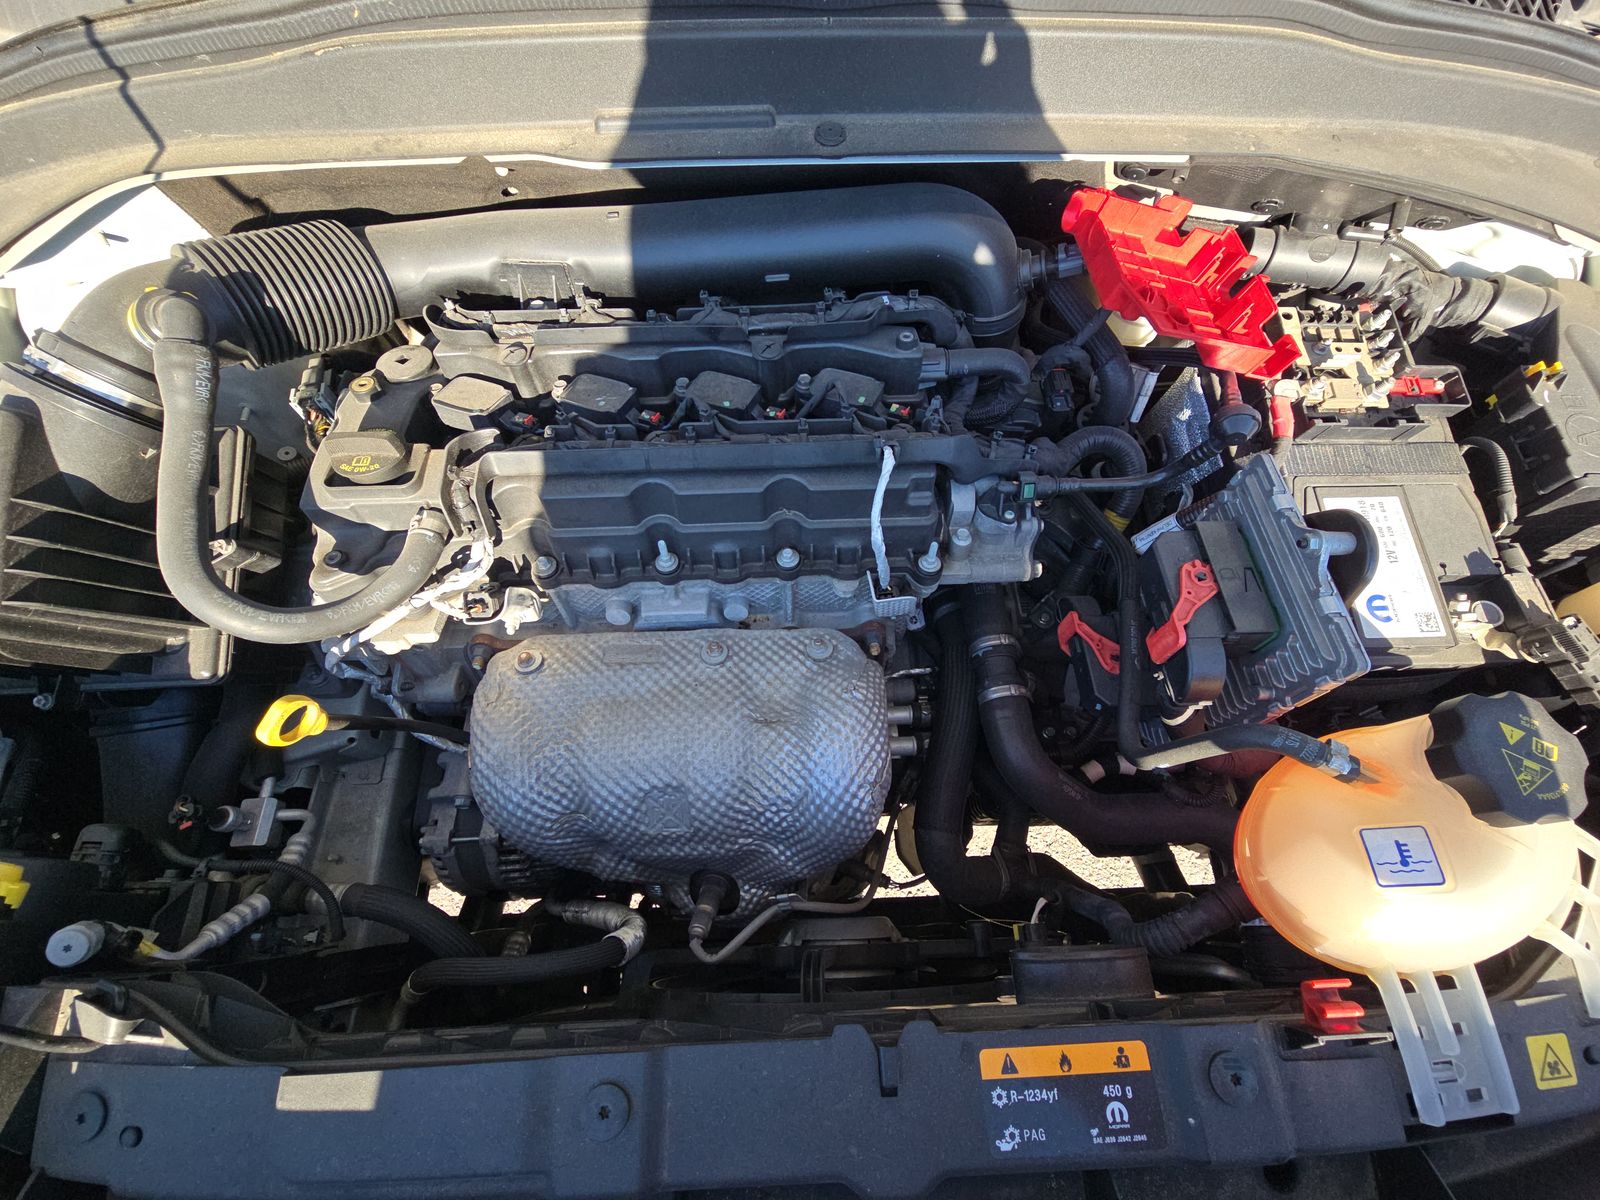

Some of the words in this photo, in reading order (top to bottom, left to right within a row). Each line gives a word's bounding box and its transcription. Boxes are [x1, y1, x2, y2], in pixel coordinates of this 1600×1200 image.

[339, 463, 353, 472] SAE
[354, 463, 380, 473] 0W-20
[1384, 549, 1400, 564] 12V
[1010, 1087, 1058, 1103] R-1234yf
[1102, 1084, 1122, 1098] 450
[1125, 1086, 1133, 1099] g
[1023, 1128, 1047, 1142] PAG
[1092, 1136, 1104, 1144] SAE
